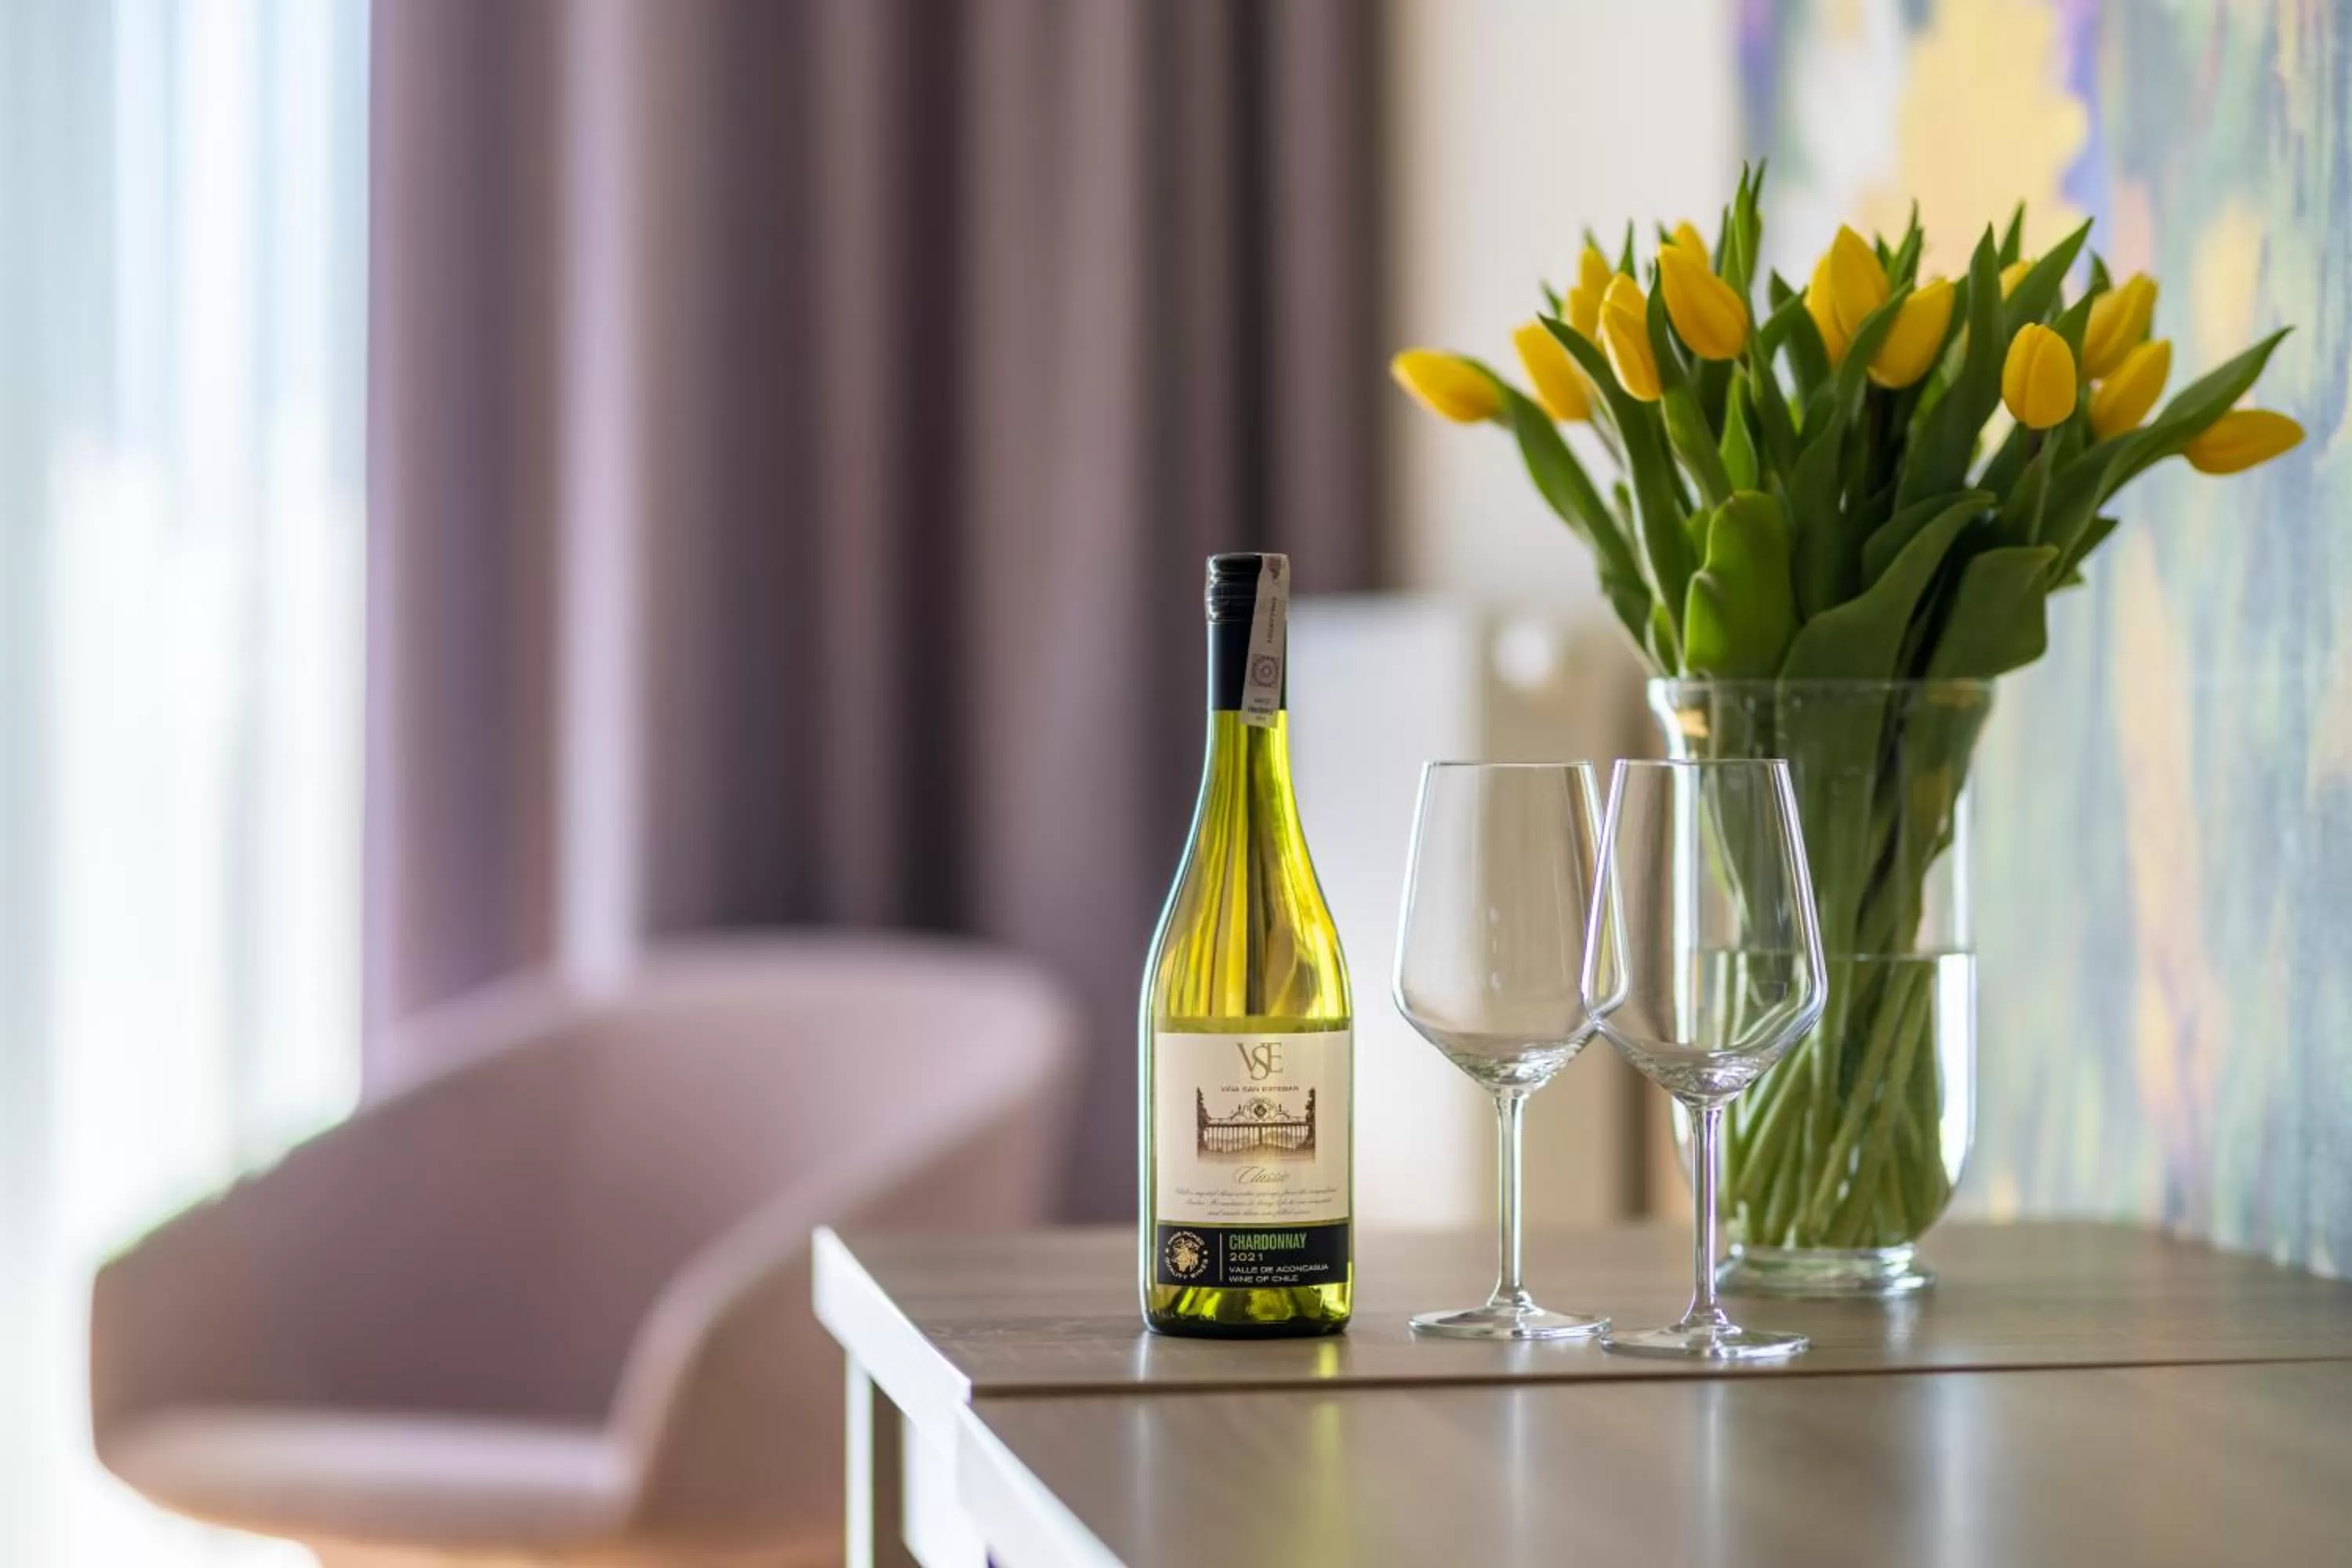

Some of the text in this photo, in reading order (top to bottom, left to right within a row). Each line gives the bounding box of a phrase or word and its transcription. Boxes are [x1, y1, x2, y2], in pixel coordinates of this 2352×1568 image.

[1236, 1042, 1283, 1080] VSE
[1229, 1232, 1307, 1250] CHARDONNAY
[1229, 1252, 1264, 1261] 2021
[1229, 1265, 1258, 1274] VALLE
